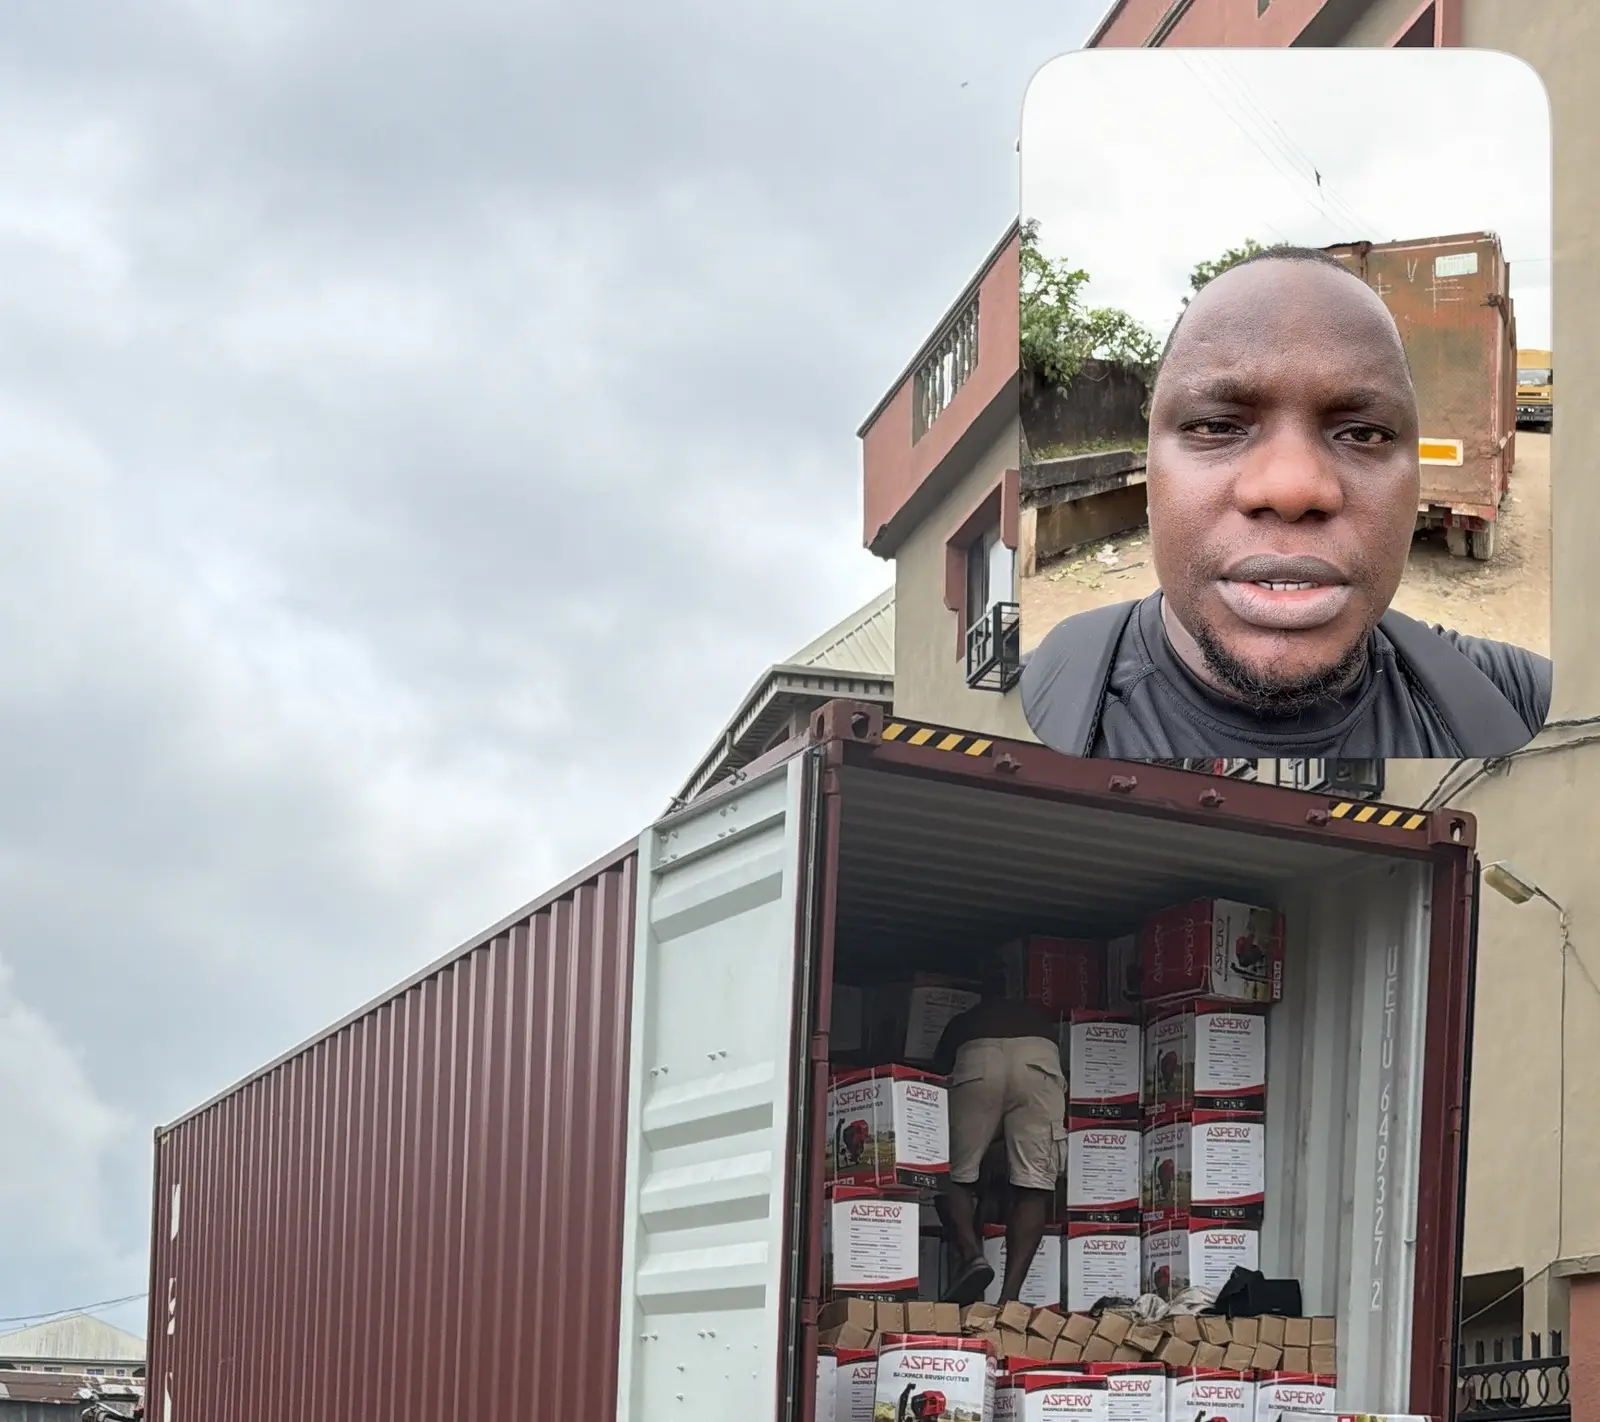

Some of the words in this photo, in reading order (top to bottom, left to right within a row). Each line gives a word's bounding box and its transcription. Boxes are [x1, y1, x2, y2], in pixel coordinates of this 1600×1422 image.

[1382, 946, 1398, 1068] UETU
[1209, 1018, 1249, 1029] ASPERO
[1085, 1026, 1126, 1038] ASPERO
[906, 1085, 938, 1101] ASPERO
[1083, 1133, 1125, 1145] ASPERO
[1207, 1127, 1249, 1138] ASPERO
[1374, 1084, 1390, 1266] 649327
[851, 1205, 901, 1218] ASPERO
[1083, 1240, 1124, 1250] ASPERO
[1204, 1234, 1245, 1245] ASPERO
[1371, 1281, 1381, 1310] 2
[899, 1355, 966, 1373] ASPERO
[852, 1368, 876, 1379] ASP
[946, 1375, 969, 1383] CUTTER
[1192, 1385, 1241, 1400] ASPERO
[1275, 1389, 1324, 1405] ASPERO
[1042, 1393, 1091, 1406] ASPERO
